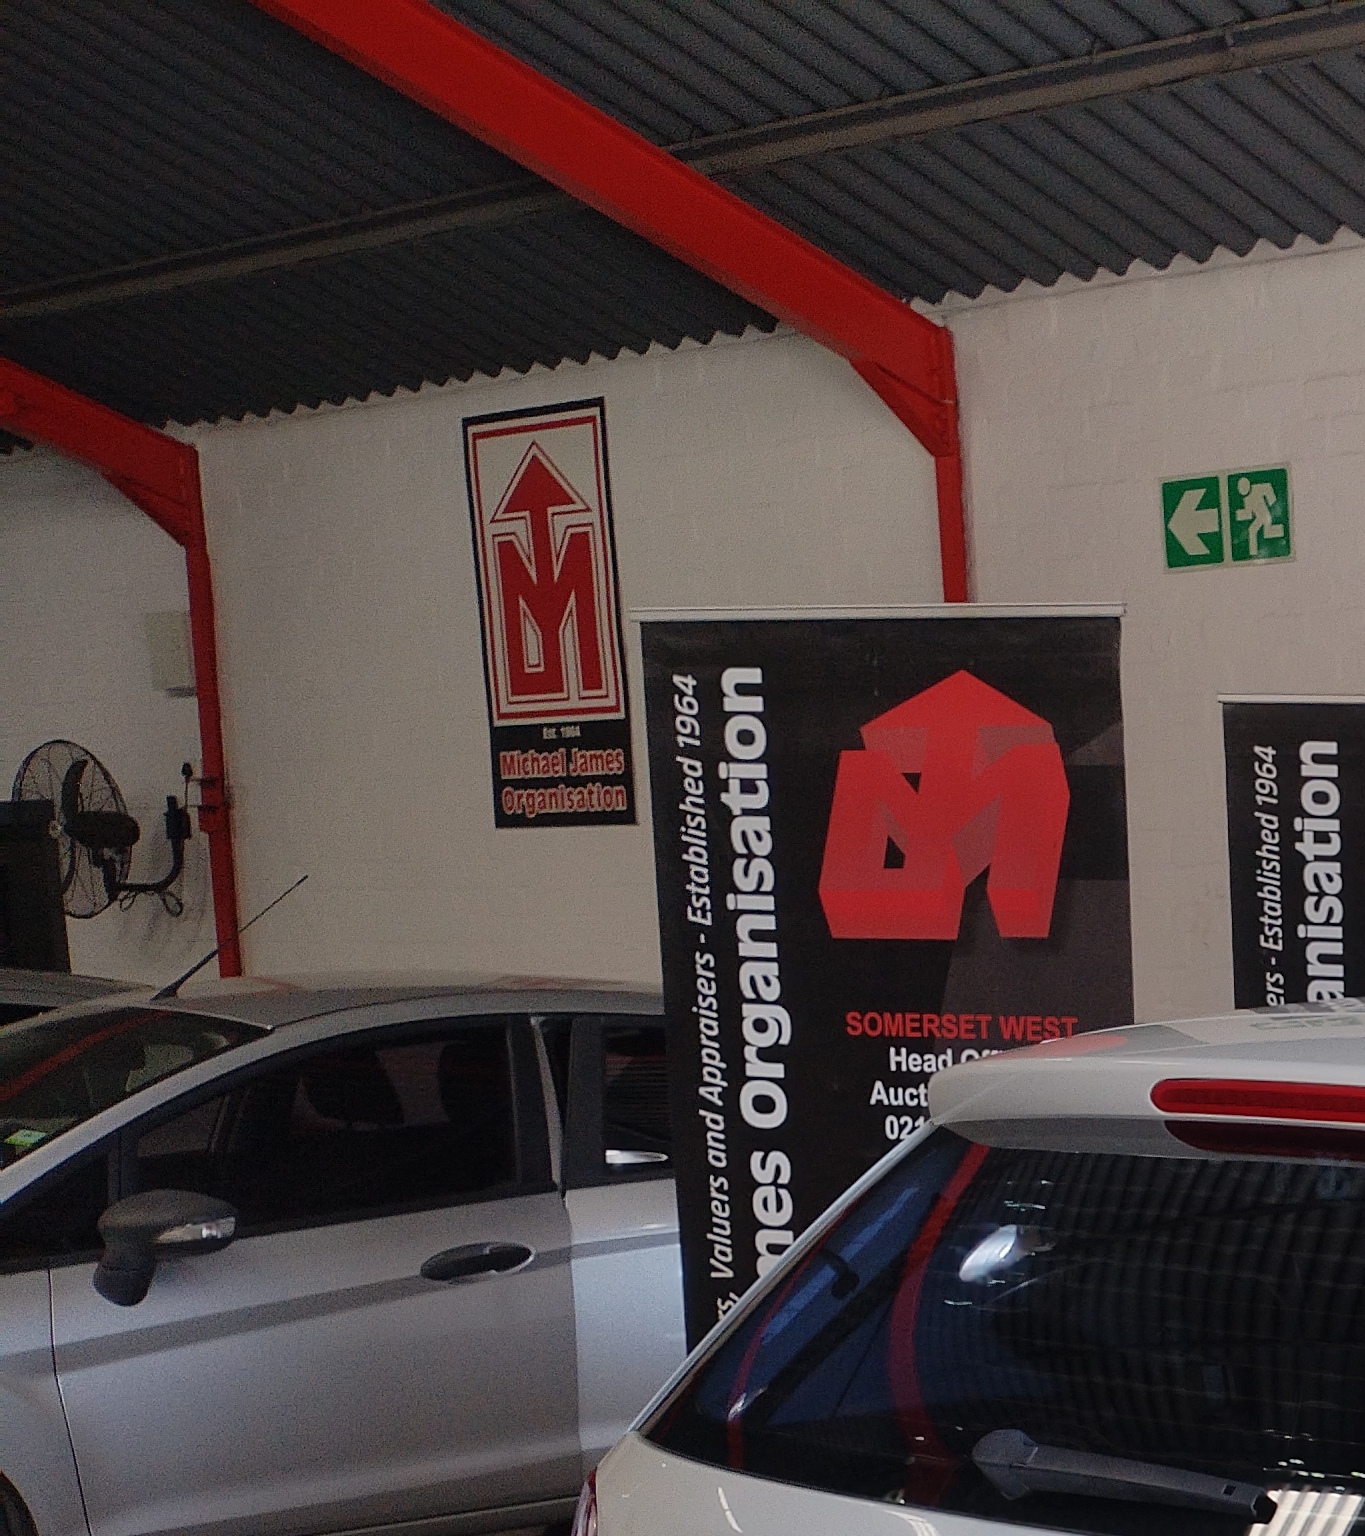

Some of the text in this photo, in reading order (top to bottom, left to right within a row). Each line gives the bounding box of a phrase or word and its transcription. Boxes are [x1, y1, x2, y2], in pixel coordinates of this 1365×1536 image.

[672, 674, 702, 749] 1964
[500, 747, 625, 779] Michael James
[1253, 745, 1280, 807] 1964
[502, 782, 627, 818] Organisation
[676, 755, 713, 926] Established
[1293, 740, 1345, 1003] anisation
[1254, 811, 1284, 952] Established
[691, 949, 729, 1106] Appraisers
[845, 1011, 1079, 1042] SOMERSET WEST
[889, 1046, 953, 1073] Head
[870, 1080, 929, 1107] Auct
[699, 1109, 729, 1168] and
[708, 1174, 735, 1280] Valuers
